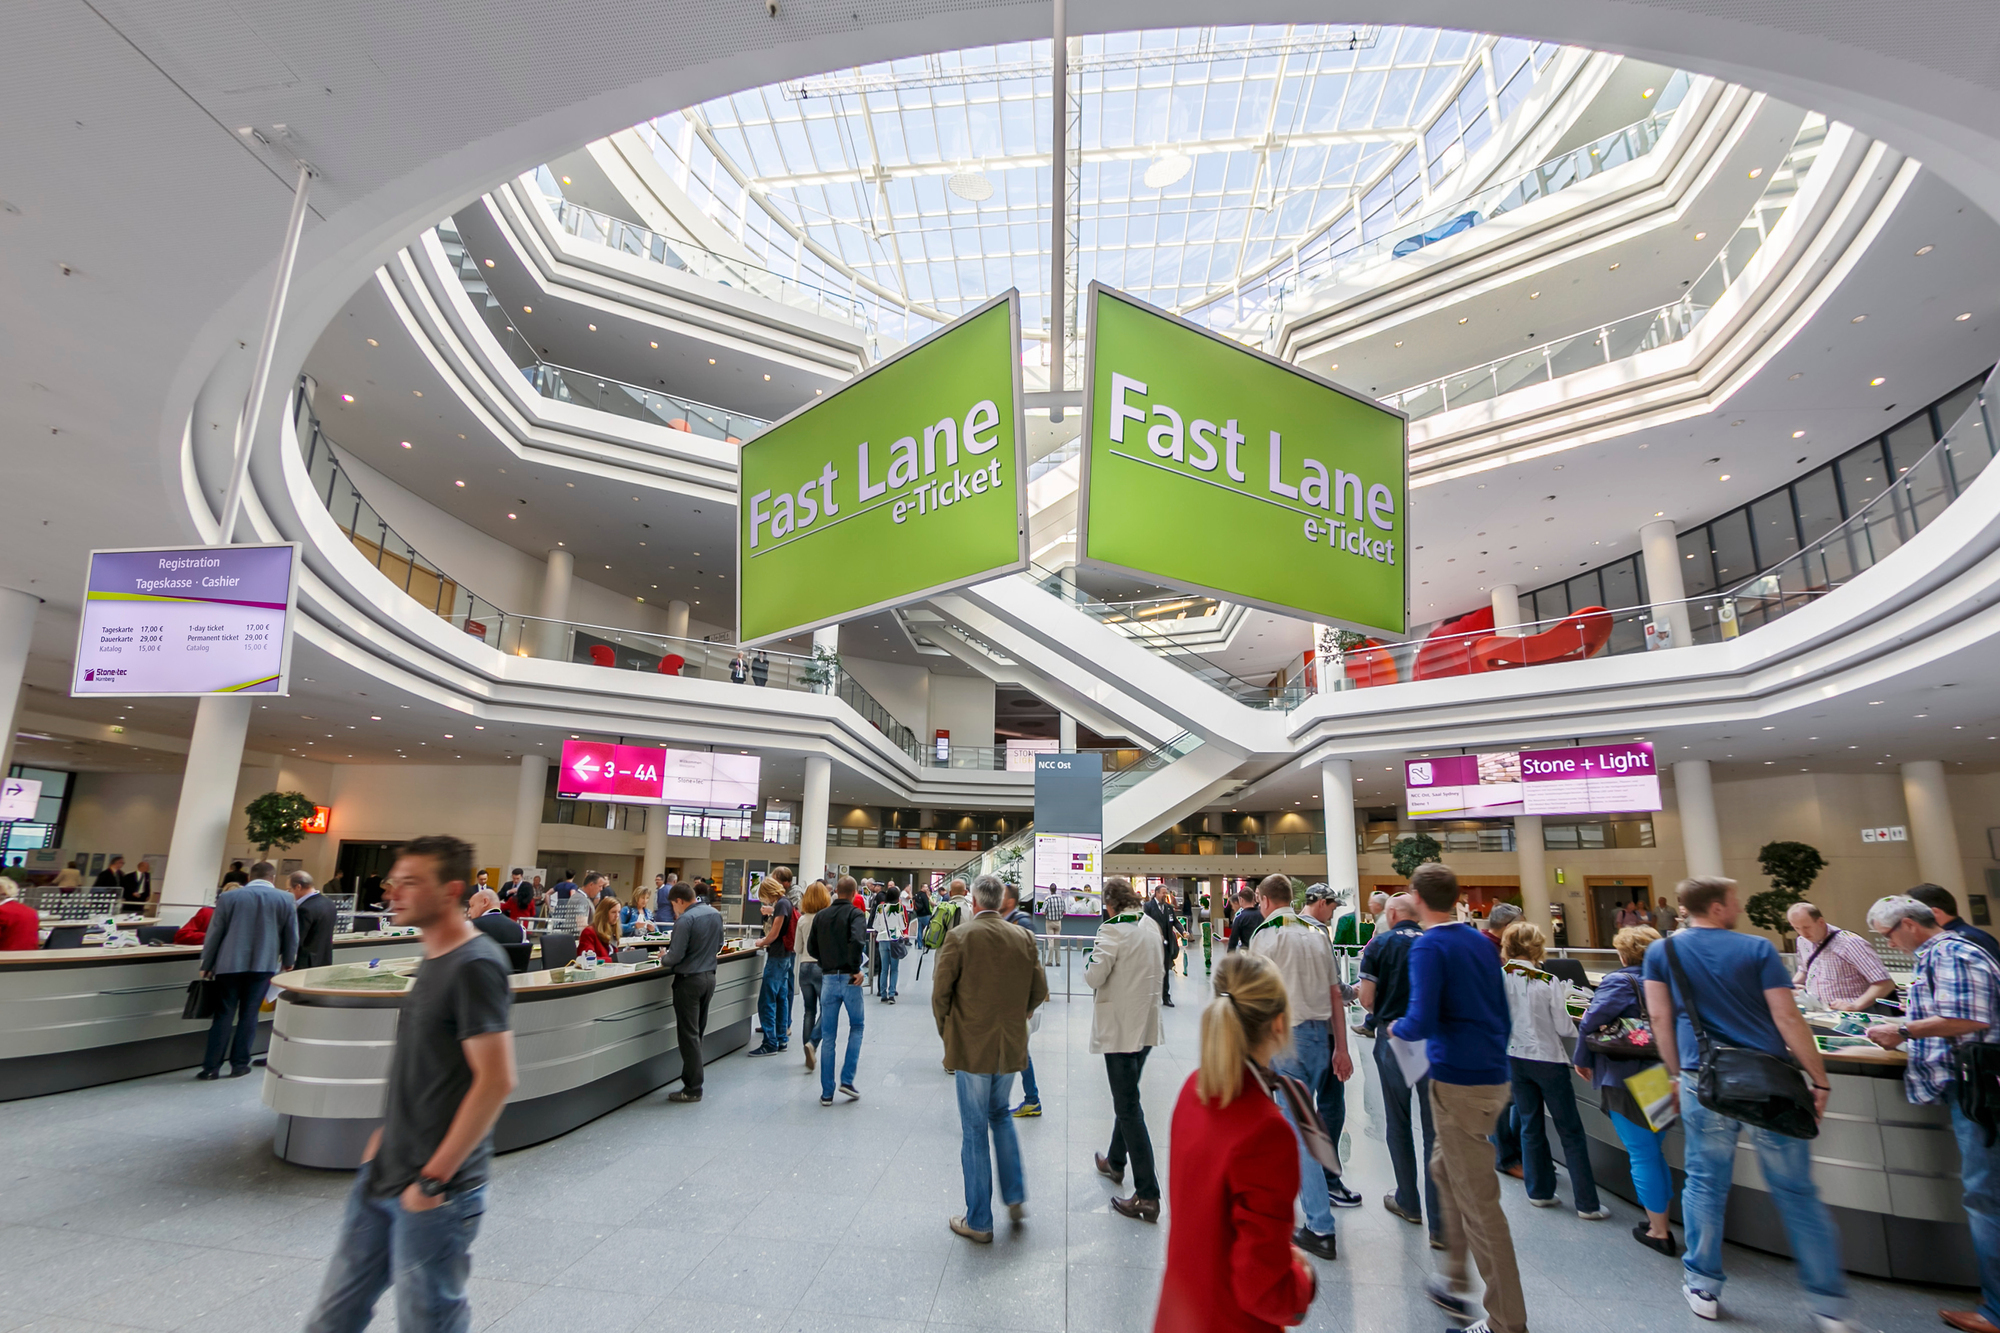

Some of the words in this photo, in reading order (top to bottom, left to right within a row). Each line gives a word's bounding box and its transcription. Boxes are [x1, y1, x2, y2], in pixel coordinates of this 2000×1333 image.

[1109, 371, 1246, 483] Fast
[1269, 430, 1395, 530] Lane
[750, 460, 839, 549] Fast
[858, 399, 1000, 503] Lane
[892, 457, 1002, 524] e-Ticket
[1303, 518, 1395, 565] e-Ticket
[158, 557, 220, 572] Registration
[135, 578, 192, 592] Tageskasse
[201, 576, 240, 588] Cashier
[102, 626, 134, 635] Tageskarte
[141, 625, 158, 634] 17,00
[189, 625, 206, 633] 1-day
[140, 635, 157, 643] 29,00
[187, 634, 220, 642] Permanent
[186, 644, 210, 652] Catalog
[1038, 761, 1056, 769] NCC
[1057, 761, 1071, 769] Ost
[1522, 758, 1576, 774] Stone
[1580, 759, 1594, 770] +
[1599, 751, 1650, 773] Light
[603, 761, 615, 778] 3
[634, 763, 657, 782] 4A
